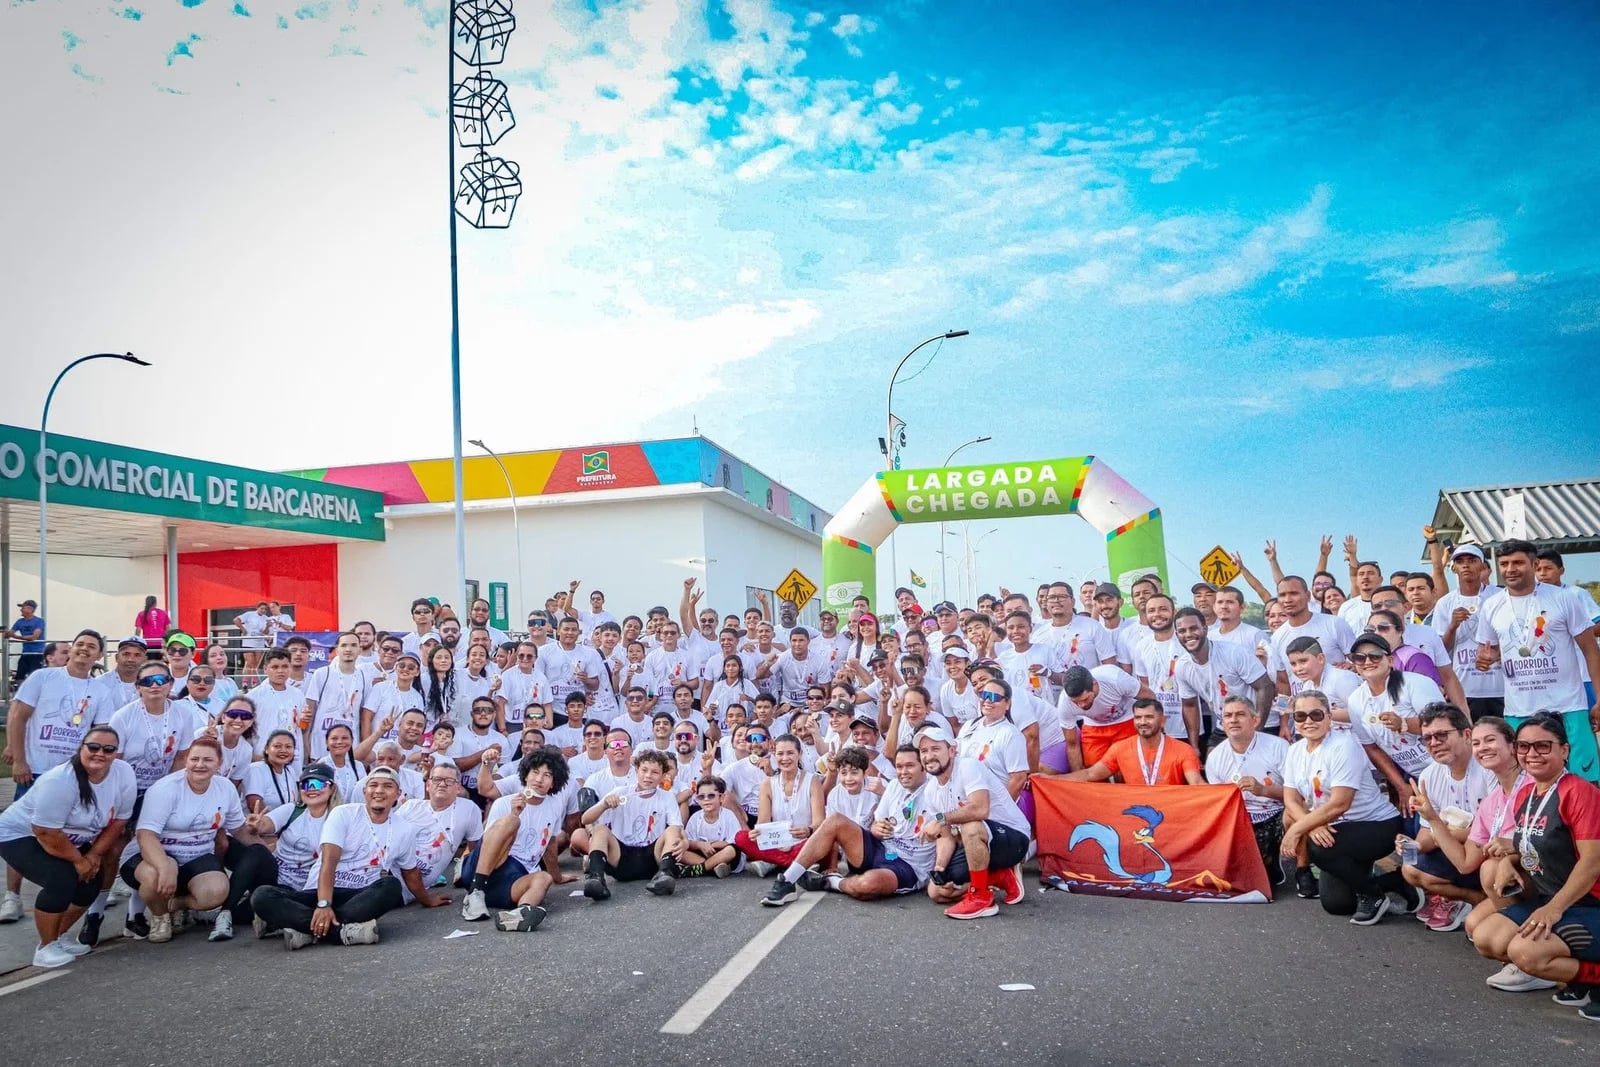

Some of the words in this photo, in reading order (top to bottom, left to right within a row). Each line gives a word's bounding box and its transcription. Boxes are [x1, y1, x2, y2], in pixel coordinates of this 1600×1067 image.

[35, 448, 202, 503] COMERCIAL
[207, 476, 239, 508] DE
[244, 482, 362, 525] BARCARENA
[576, 474, 617, 482] PREFEITURA
[906, 464, 1057, 491] LARGADA
[906, 486, 1062, 513] CHEGADA
[1514, 658, 1549, 670] CORRIDA
[1552, 656, 1558, 667] E
